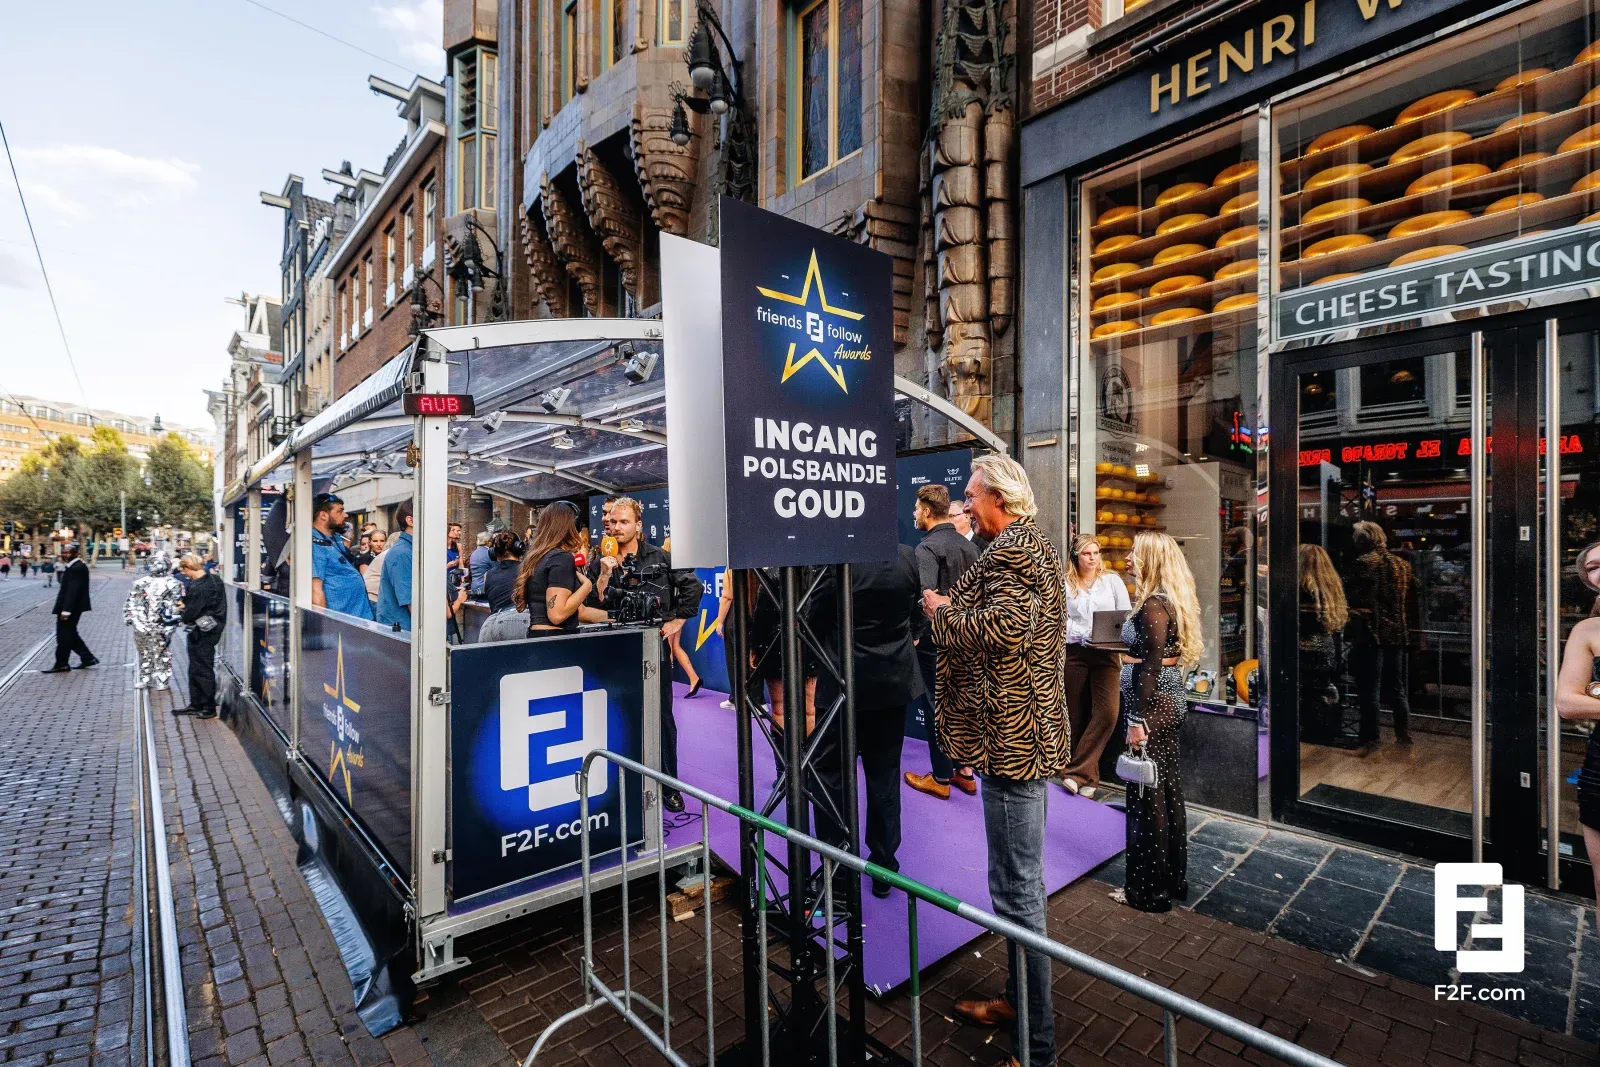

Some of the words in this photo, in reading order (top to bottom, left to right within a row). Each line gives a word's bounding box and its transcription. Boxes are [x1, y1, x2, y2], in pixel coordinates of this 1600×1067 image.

[1151, 0, 1315, 113] HENRI
[1295, 280, 1419, 325] CHEESE
[757, 306, 803, 330] friends
[827, 324, 862, 344] follow
[833, 343, 872, 360] Awards
[420, 397, 460, 412] AUB
[754, 417, 877, 458] INGANG
[743, 455, 887, 484] POLSBANDJE
[773, 487, 866, 518] GOUD
[501, 812, 609, 858] F2F.com
